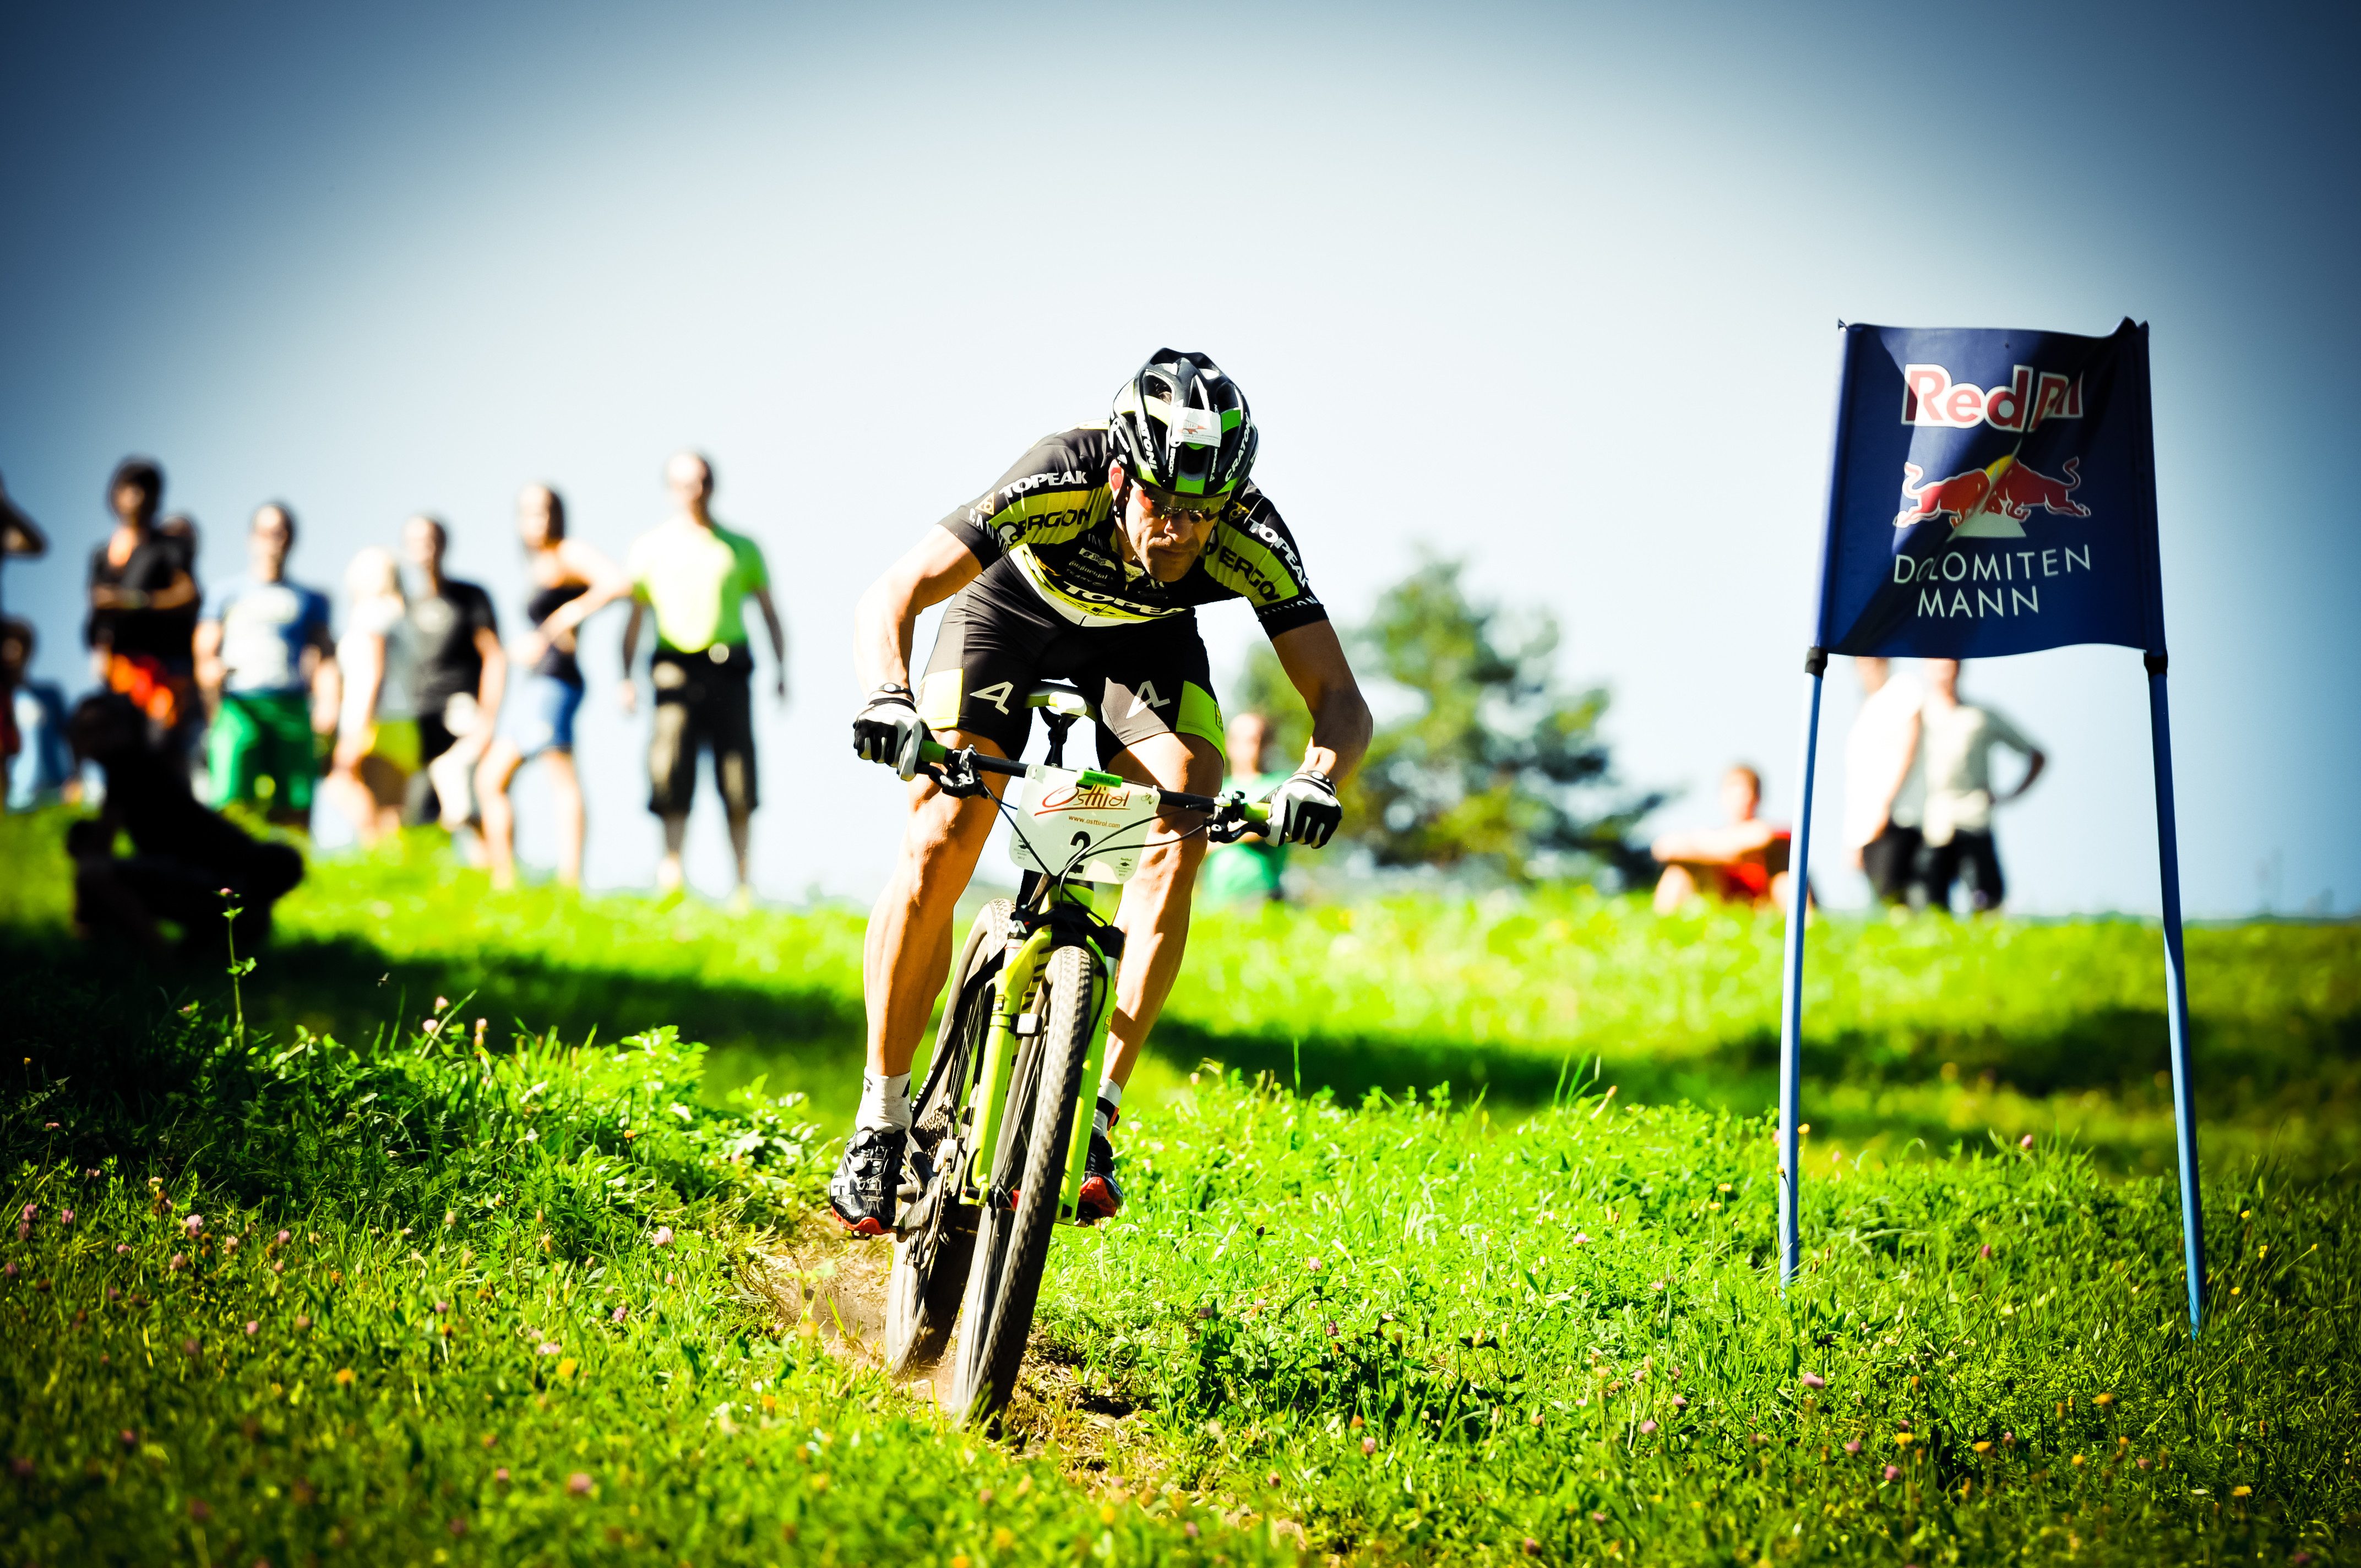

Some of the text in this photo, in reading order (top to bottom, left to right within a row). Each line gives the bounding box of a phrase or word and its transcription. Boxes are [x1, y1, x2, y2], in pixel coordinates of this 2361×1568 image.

[1902, 364, 2033, 432] Red
[999, 470, 1087, 498] TOPEAK
[1063, 580, 1186, 616] TOPEA
[1917, 586, 2038, 618] MANN
[1068, 815, 1120, 829] www.osttirol.com
[1065, 830, 1091, 874] 2
